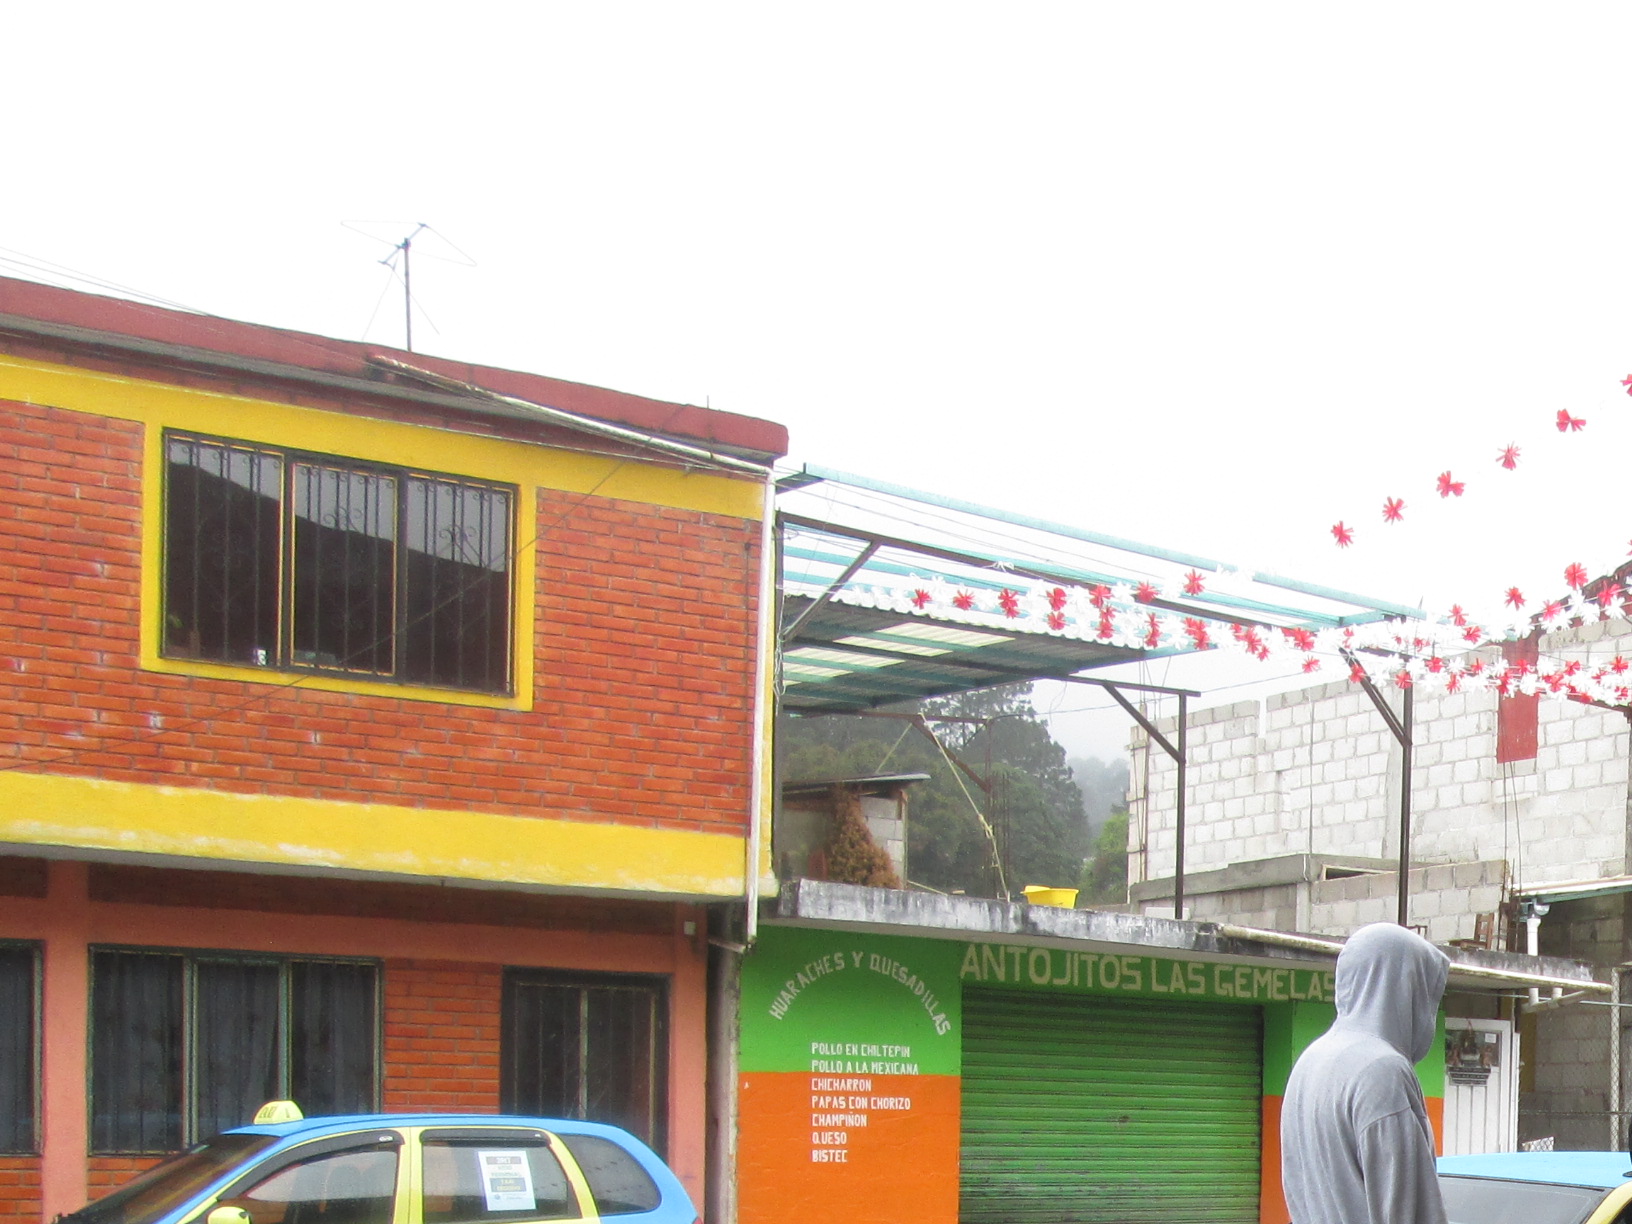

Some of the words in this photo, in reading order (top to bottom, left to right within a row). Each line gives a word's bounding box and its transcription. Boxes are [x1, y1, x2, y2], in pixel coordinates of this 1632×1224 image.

[960, 943, 1142, 991] ANTOJITOS
[1151, 961, 1206, 994] LAS
[768, 952, 845, 1020] HUARACHES
[852, 951, 864, 968] Y
[869, 953, 951, 1036] QUESADILLAS
[811, 1042, 842, 1055] POLLO
[845, 1043, 858, 1056] EN
[861, 1044, 910, 1058] CHILTEPIN
[811, 1060, 842, 1073] POLLO
[846, 1062, 853, 1074] A
[856, 1062, 868, 1074] LA
[871, 1062, 919, 1075] MEXICANA
[811, 1078, 872, 1092] CHICHARRON
[811, 1096, 846, 1109] PAPAS
[848, 1096, 868, 1110] CON
[870, 1097, 911, 1110] CHORIZO
[811, 1111, 868, 1127] CHAMPIÑON
[811, 1132, 847, 1145] QUESO
[811, 1150, 848, 1163] BISTEC
